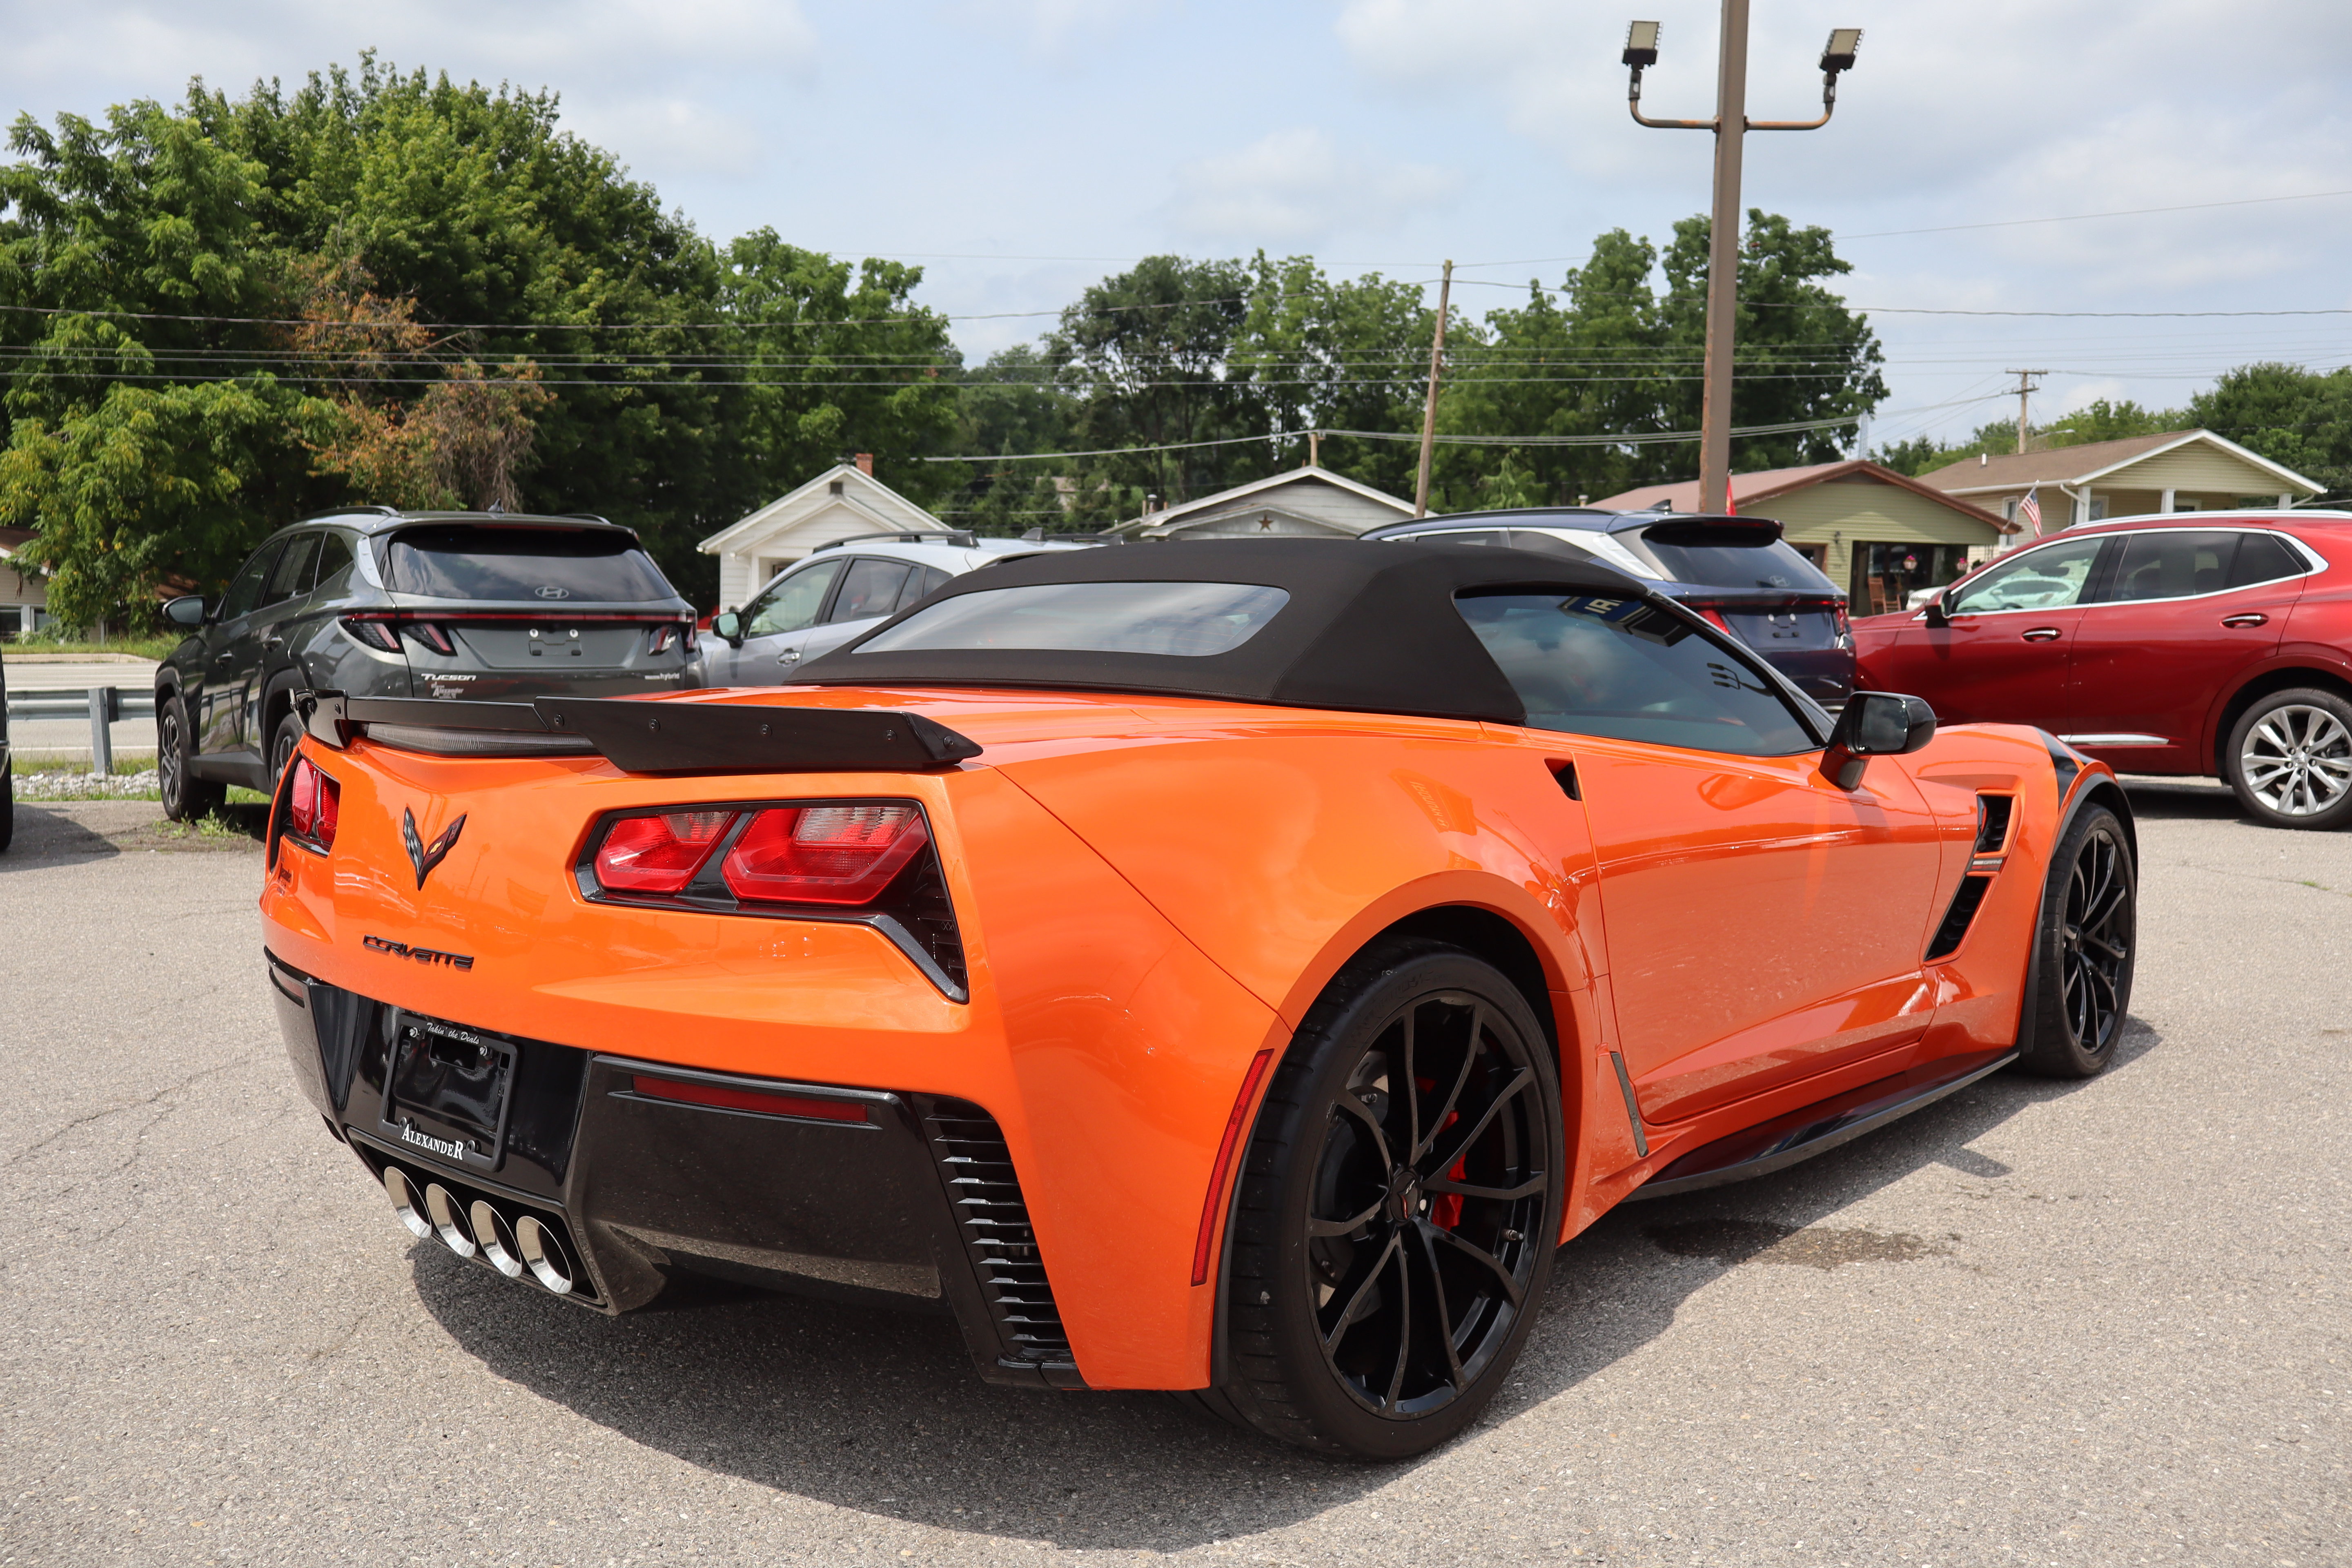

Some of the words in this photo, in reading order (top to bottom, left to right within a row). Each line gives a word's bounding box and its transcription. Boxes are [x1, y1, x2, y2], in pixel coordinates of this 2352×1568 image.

[363, 934, 474, 969] CORVETTE
[427, 1022, 448, 1035] Takin'
[448, 1029, 458, 1038] the
[460, 1031, 480, 1044] Deals
